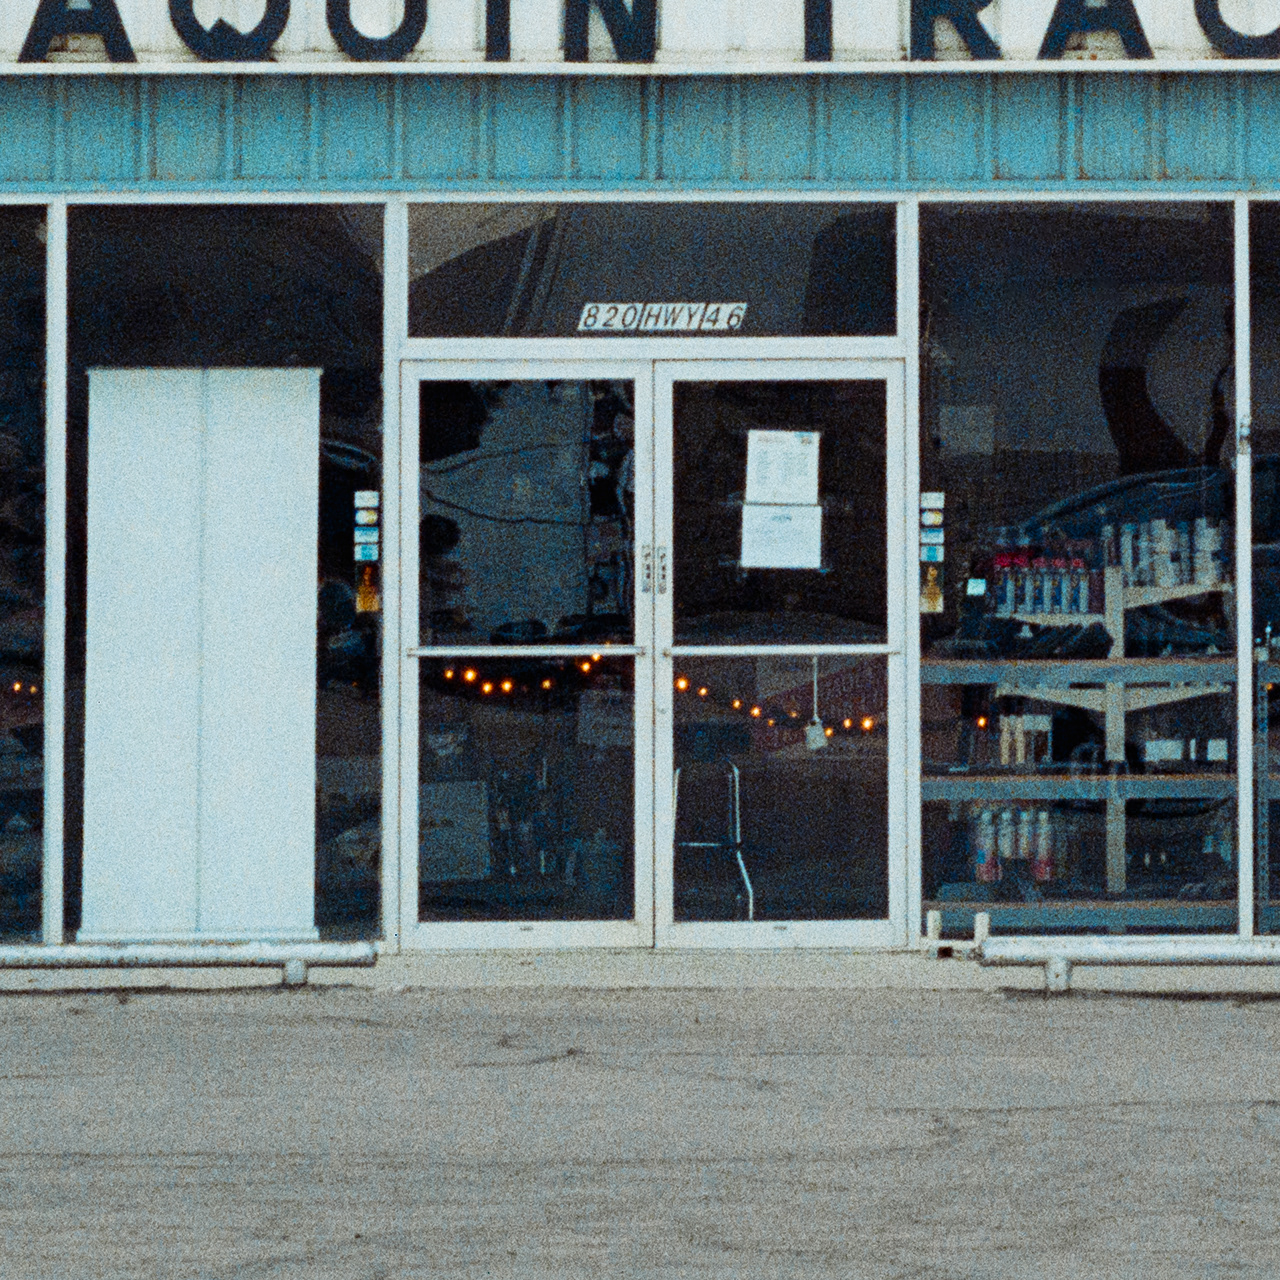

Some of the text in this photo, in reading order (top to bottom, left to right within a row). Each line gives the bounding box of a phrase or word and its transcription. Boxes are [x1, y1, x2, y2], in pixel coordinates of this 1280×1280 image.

[583, 305, 745, 328] 820 HWY 46
